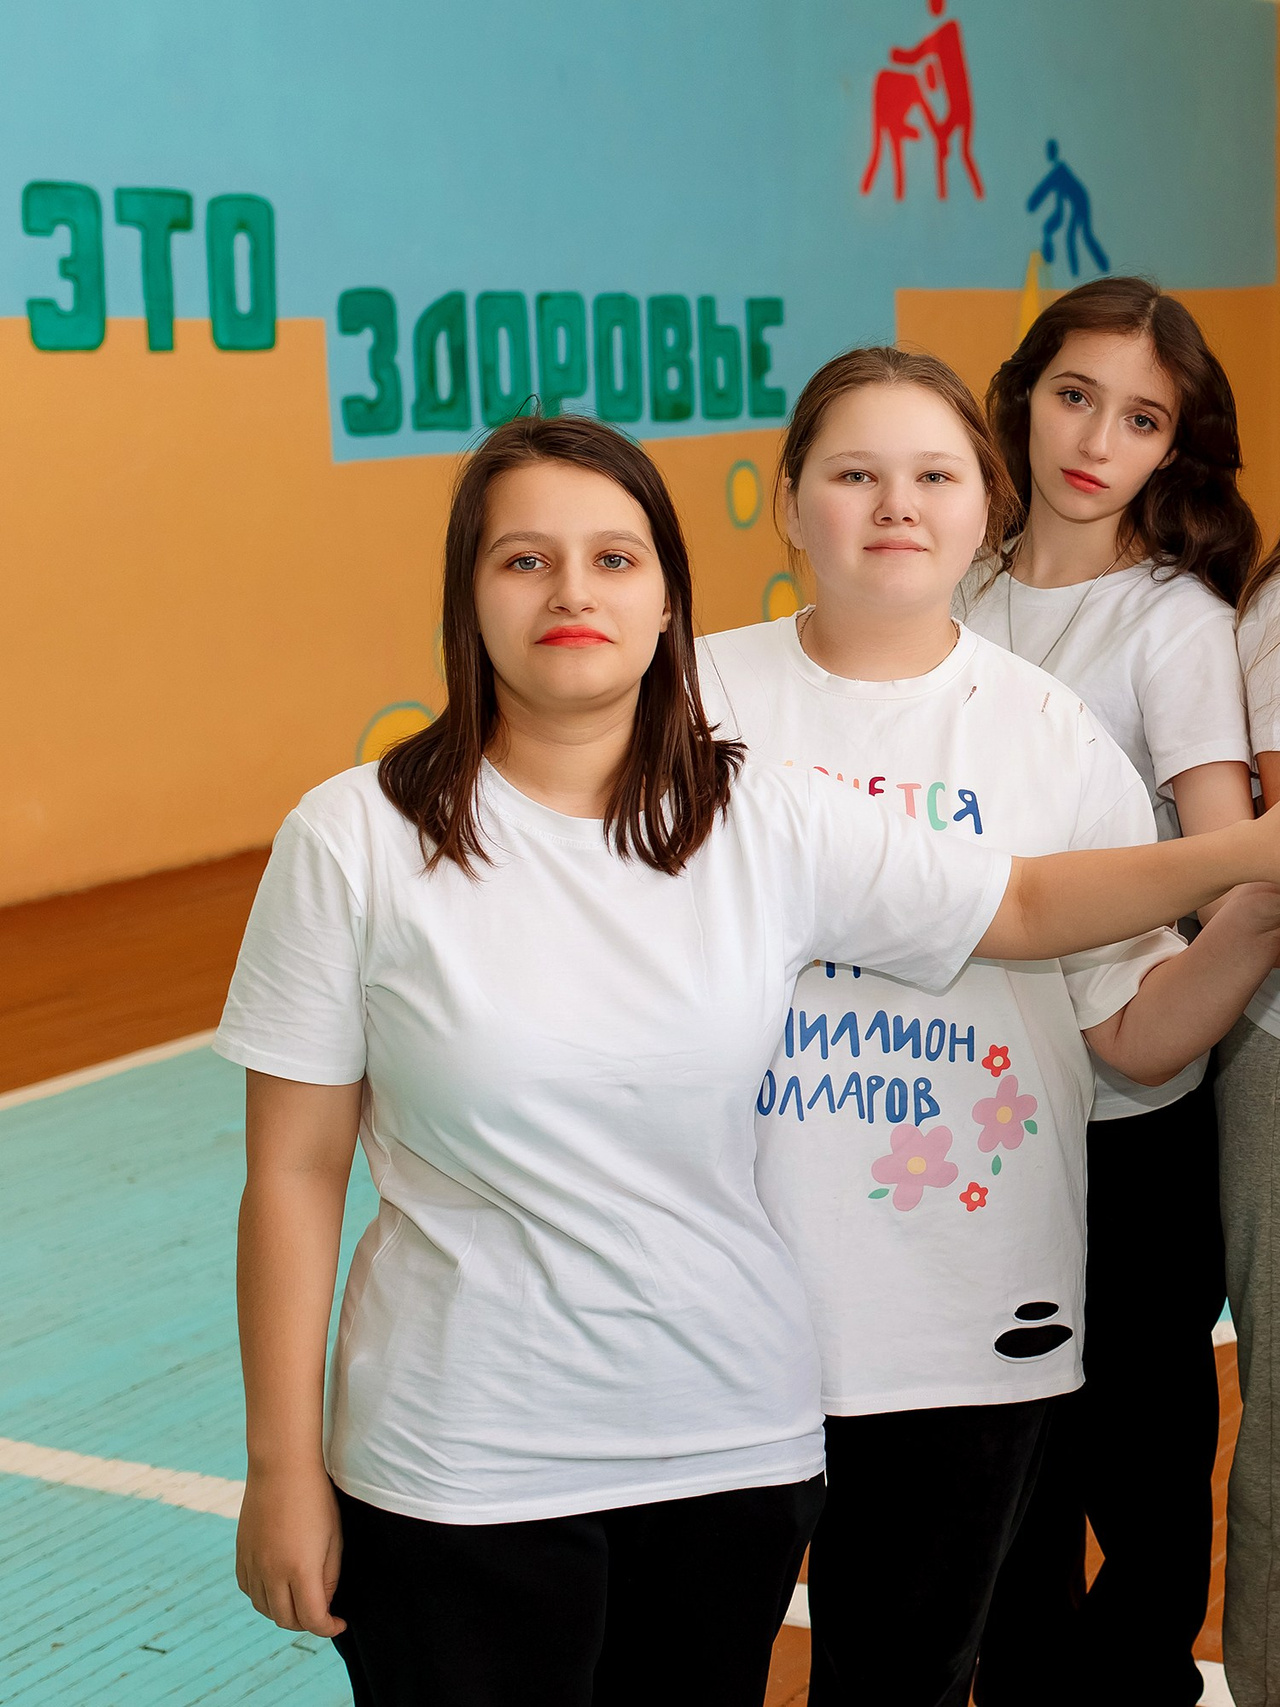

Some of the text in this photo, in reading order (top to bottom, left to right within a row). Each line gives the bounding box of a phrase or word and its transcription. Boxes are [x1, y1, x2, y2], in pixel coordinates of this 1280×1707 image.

[22, 180, 277, 352] ЭТО
[337, 287, 787, 436] ЗДОРОВЬЕ
[756, 1069, 941, 1127] ОЛЛАРОВ
